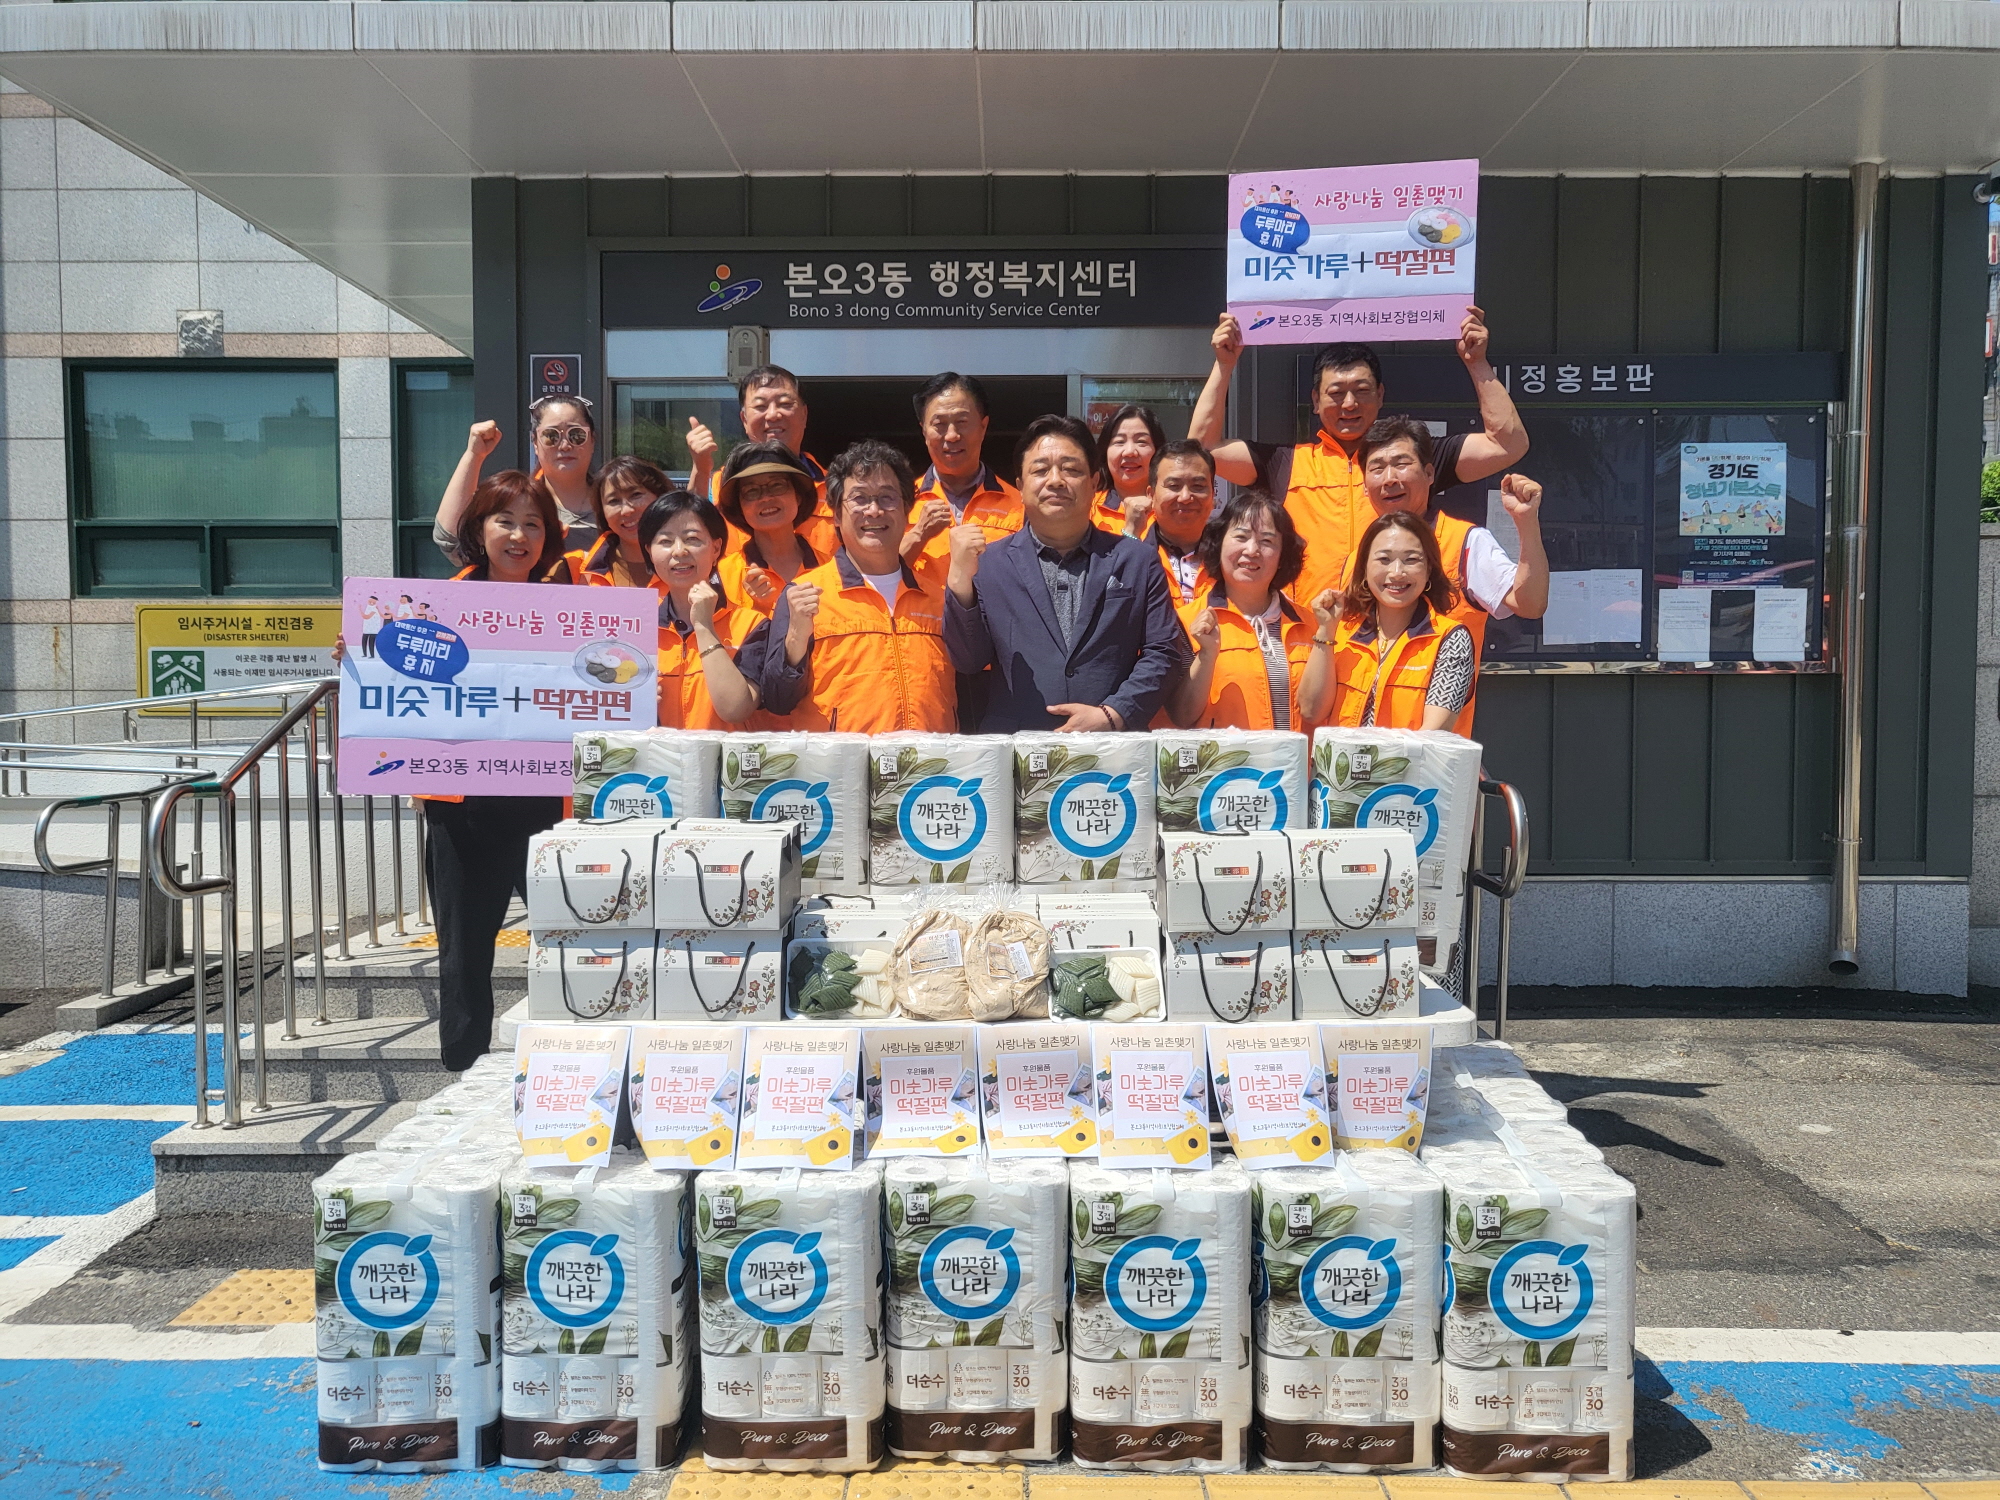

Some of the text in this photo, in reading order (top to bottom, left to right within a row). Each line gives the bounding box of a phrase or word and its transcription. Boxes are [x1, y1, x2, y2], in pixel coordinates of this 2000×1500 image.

[1314, 184, 1464, 211] 사랑나눔 일촌맺기
[1255, 215, 1296, 235] 두루마리
[783, 260, 1137, 298] 본오3동 행정복지센터
[789, 303, 1100, 321] Bono 3 dong Community Service Center
[1278, 309, 1446, 328] 본오3동 지역사회보장협의체
[1708, 463, 1759, 480] 경기도
[1685, 480, 1782, 500] 청년기본소득
[177, 616, 253, 631] 임시주거시설
[264, 616, 314, 631] 지진겸용
[457, 609, 641, 638] 사랑나눔 일촌맺기
[203, 633, 289, 642] (DISASTER SHELTER)
[396, 633, 451, 660] 두루마리
[236, 654, 257, 663] 이곳은
[276, 654, 291, 663] 재난
[310, 654, 317, 662] 시
[213, 668, 242, 677] 사용되는
[409, 758, 470, 775] 본오3동
[609, 798, 656, 816] 깨끗한
[768, 804, 816, 821] 깨끗한
[916, 802, 968, 821] 깨끗한
[1067, 799, 1119, 817] 깨끗한
[1217, 795, 1269, 813] 깨끗한
[1226, 814, 1261, 830] 나라
[1374, 809, 1422, 827] 깨끗한
[926, 822, 962, 840] 나라
[1076, 819, 1112, 836] 나라
[1422, 902, 1436, 911] 3겹
[1422, 912, 1436, 921] 30
[532, 1038, 617, 1051] 사랑나눔 일촌맺기
[647, 1039, 733, 1052] 사랑나눔 일촌맺기
[763, 1040, 848, 1053] 사랑나눔 일촌맺기
[880, 1040, 965, 1054] 사랑나눔 일촌맺기
[996, 1035, 1080, 1051] 사랑나눔 일촌맺기
[1110, 1036, 1196, 1049] 사랑나눔 일촌맺기
[1226, 1036, 1311, 1050] 사랑나눔 일촌맺기
[1338, 1038, 1422, 1052] 사랑나눔 일촌맺기
[536, 1094, 587, 1112] 떡절편
[655, 1095, 708, 1114] 떡절편
[772, 1096, 824, 1114] 떡절편
[897, 1096, 948, 1116] 떡절편
[1014, 1092, 1064, 1112] 떡절편
[1128, 1094, 1180, 1112] 떡절편
[1247, 1093, 1300, 1112] 떡절편
[1352, 1096, 1403, 1114] 떡절편
[1482, 1214, 1496, 1225] 3겹
[358, 1262, 418, 1284] 깨끗한
[546, 1262, 604, 1282] 깨끗한
[748, 1260, 807, 1281] 깨끗한
[940, 1255, 1000, 1276] 깨끗한
[1125, 1267, 1186, 1287] 깨끗한
[1321, 1267, 1381, 1288] 깨끗한
[1510, 1272, 1572, 1293] 깨끗한
[369, 1285, 410, 1304] 나라
[556, 1284, 596, 1303] 나라
[758, 1282, 799, 1300] 나라
[951, 1277, 990, 1296] 나라
[1136, 1288, 1177, 1308] 나라
[1332, 1288, 1372, 1306] 나라
[1521, 1295, 1563, 1314] 나라
[434, 1374, 451, 1384] 3겹
[822, 1372, 840, 1382] 3겹
[1012, 1364, 1030, 1376] 3겹
[617, 1374, 634, 1385] 3겹
[717, 1380, 755, 1396] 더순수
[906, 1374, 946, 1390] 더순수
[1012, 1376, 1030, 1388] 30
[1200, 1377, 1217, 1388] 3겹
[1392, 1376, 1408, 1388] 3겹
[327, 1384, 366, 1402] 더순수
[434, 1386, 452, 1398] 30
[513, 1380, 551, 1398] 더순수
[616, 1386, 634, 1398] 30
[823, 1383, 840, 1395] 30
[1092, 1386, 1132, 1400] 더순수
[1200, 1388, 1218, 1401] 30
[1284, 1384, 1323, 1400] 더순수
[1392, 1388, 1408, 1400] 30
[1586, 1386, 1603, 1398] 3겹
[1474, 1394, 1515, 1410] 더순수
[1586, 1398, 1604, 1410] 30
[534, 1429, 619, 1448] Pure & Deco
[740, 1430, 830, 1447] Pure & Deco
[928, 1421, 1017, 1439] Pure & Deco
[348, 1432, 440, 1454] Pure Deco
[1116, 1432, 1204, 1450] Pure Deco
[1306, 1432, 1396, 1450] Pure & Deco
[1497, 1442, 1590, 1460] Pure & Deco
